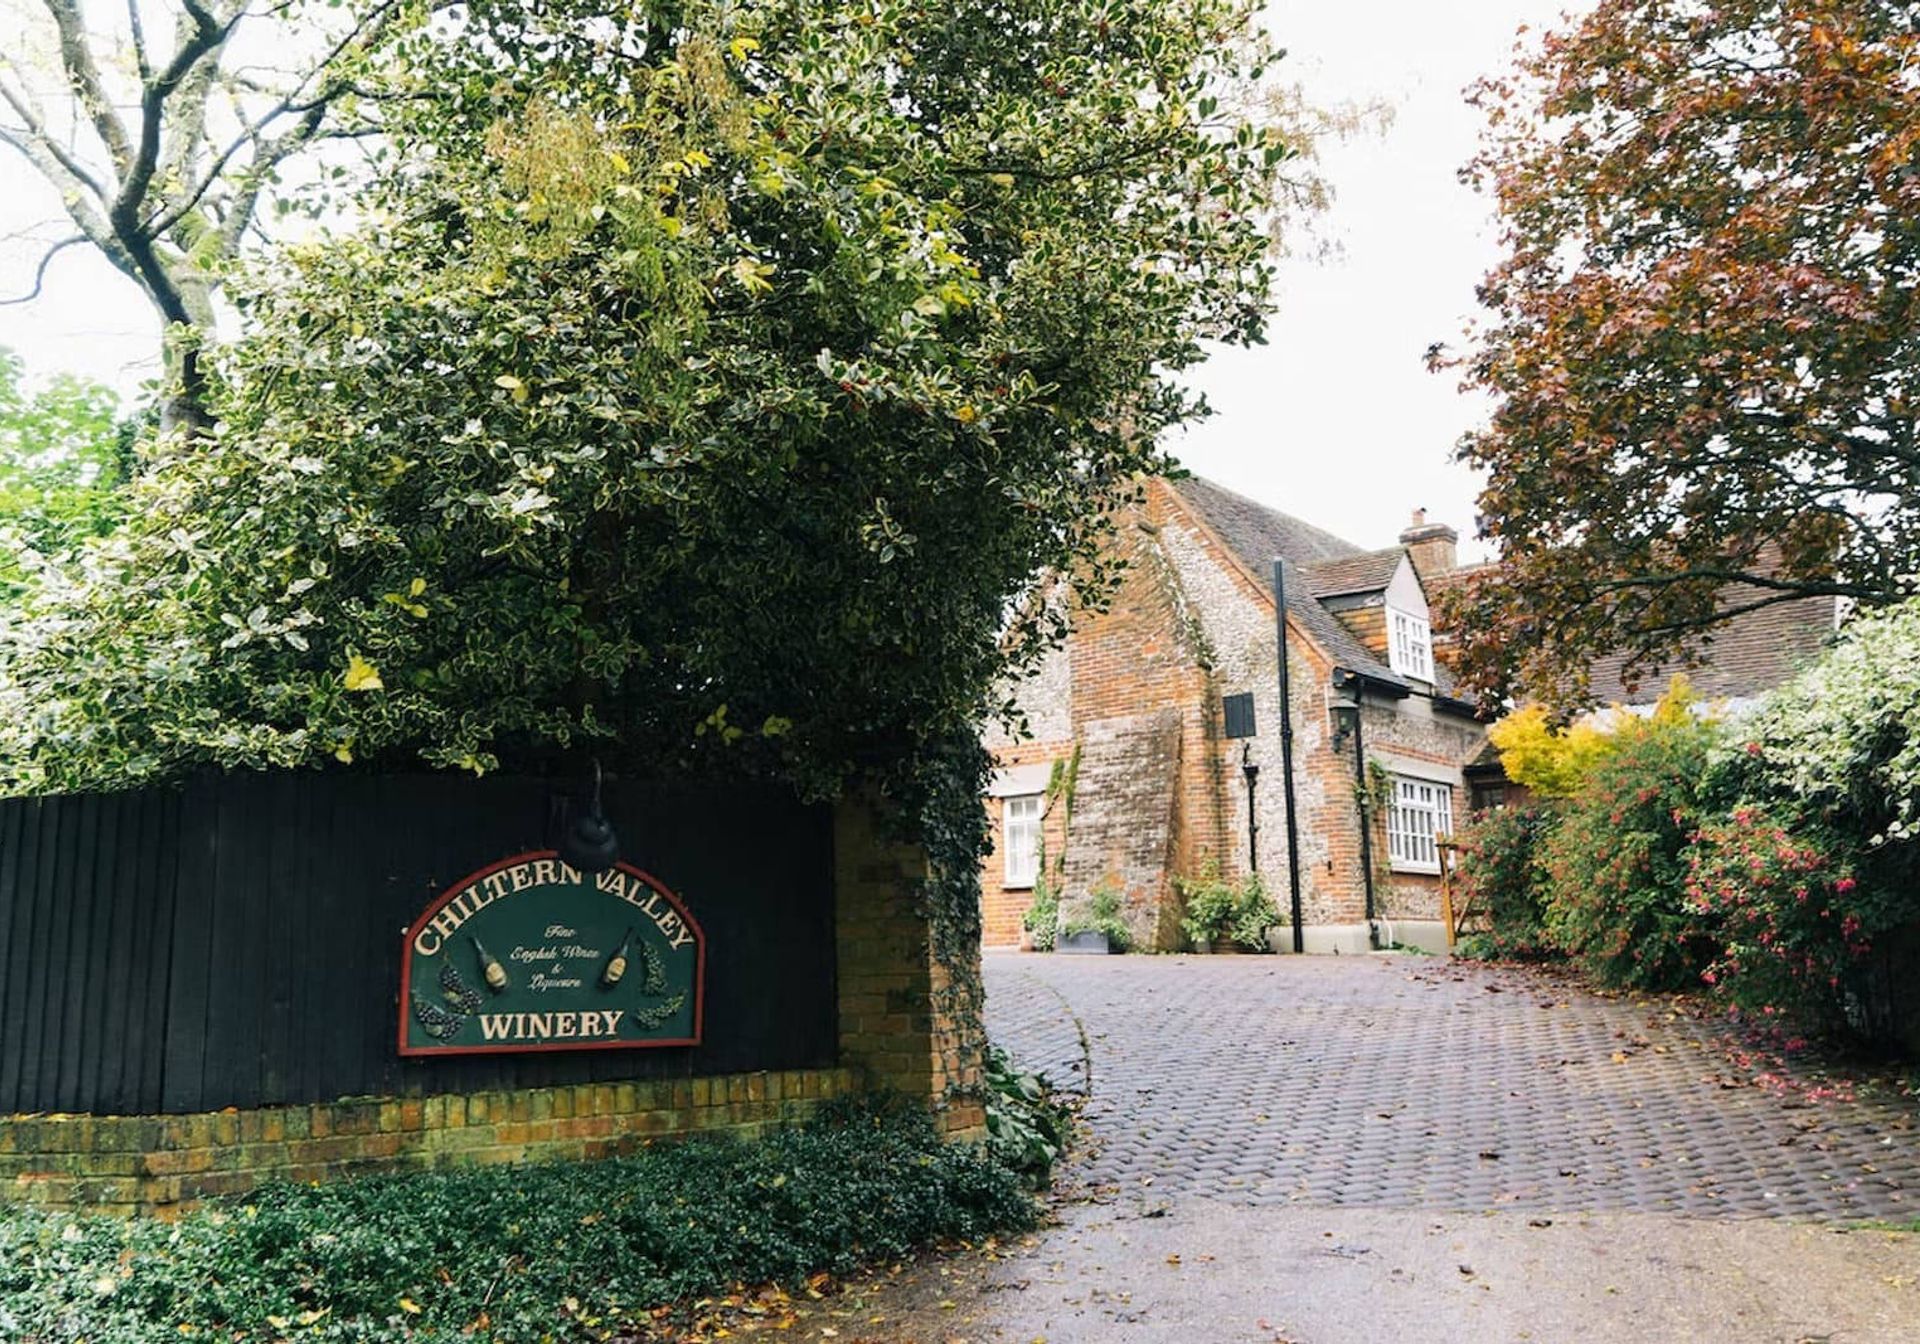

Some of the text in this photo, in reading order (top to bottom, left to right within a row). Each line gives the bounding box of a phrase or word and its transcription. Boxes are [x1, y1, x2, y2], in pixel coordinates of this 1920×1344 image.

[414, 859, 695, 956] CHILTERN VALLEY
[545, 925, 577, 938] Fine
[510, 945, 600, 963] English Wines
[551, 963, 564, 973] &
[479, 1010, 624, 1040] WINERY
